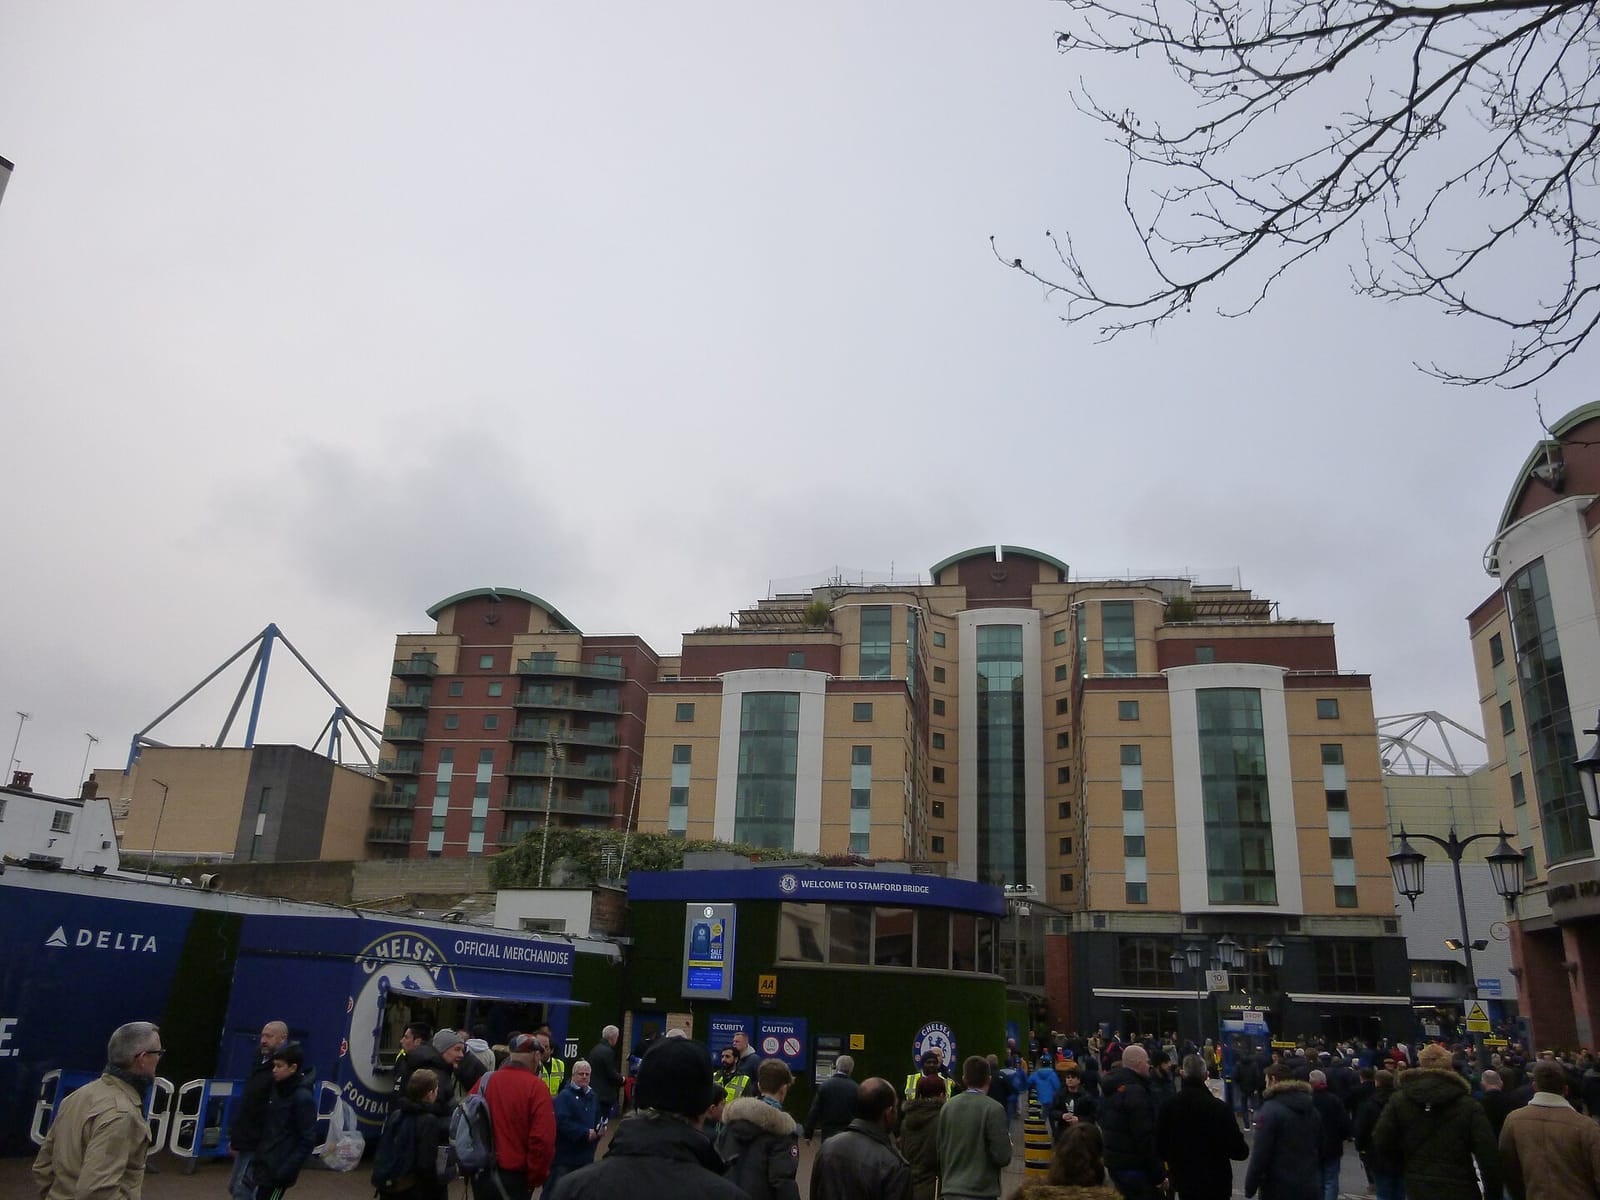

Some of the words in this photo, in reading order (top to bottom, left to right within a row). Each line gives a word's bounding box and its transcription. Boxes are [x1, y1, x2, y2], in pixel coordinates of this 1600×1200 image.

[801, 879, 843, 889] WELCOME
[845, 881, 857, 889] TO
[858, 882, 901, 892] STAMFORD
[903, 884, 929, 893] BRIDGE
[76, 929, 157, 952] DELTA
[362, 938, 441, 981] CHELSEA
[454, 940, 500, 958] OFFICIAL
[502, 945, 569, 965] MERCHANDISE
[760, 979, 774, 989] AA
[712, 1023, 745, 1032] SECURITY
[761, 1025, 794, 1034] CAUTION
[921, 1023, 950, 1037] CHELSEA
